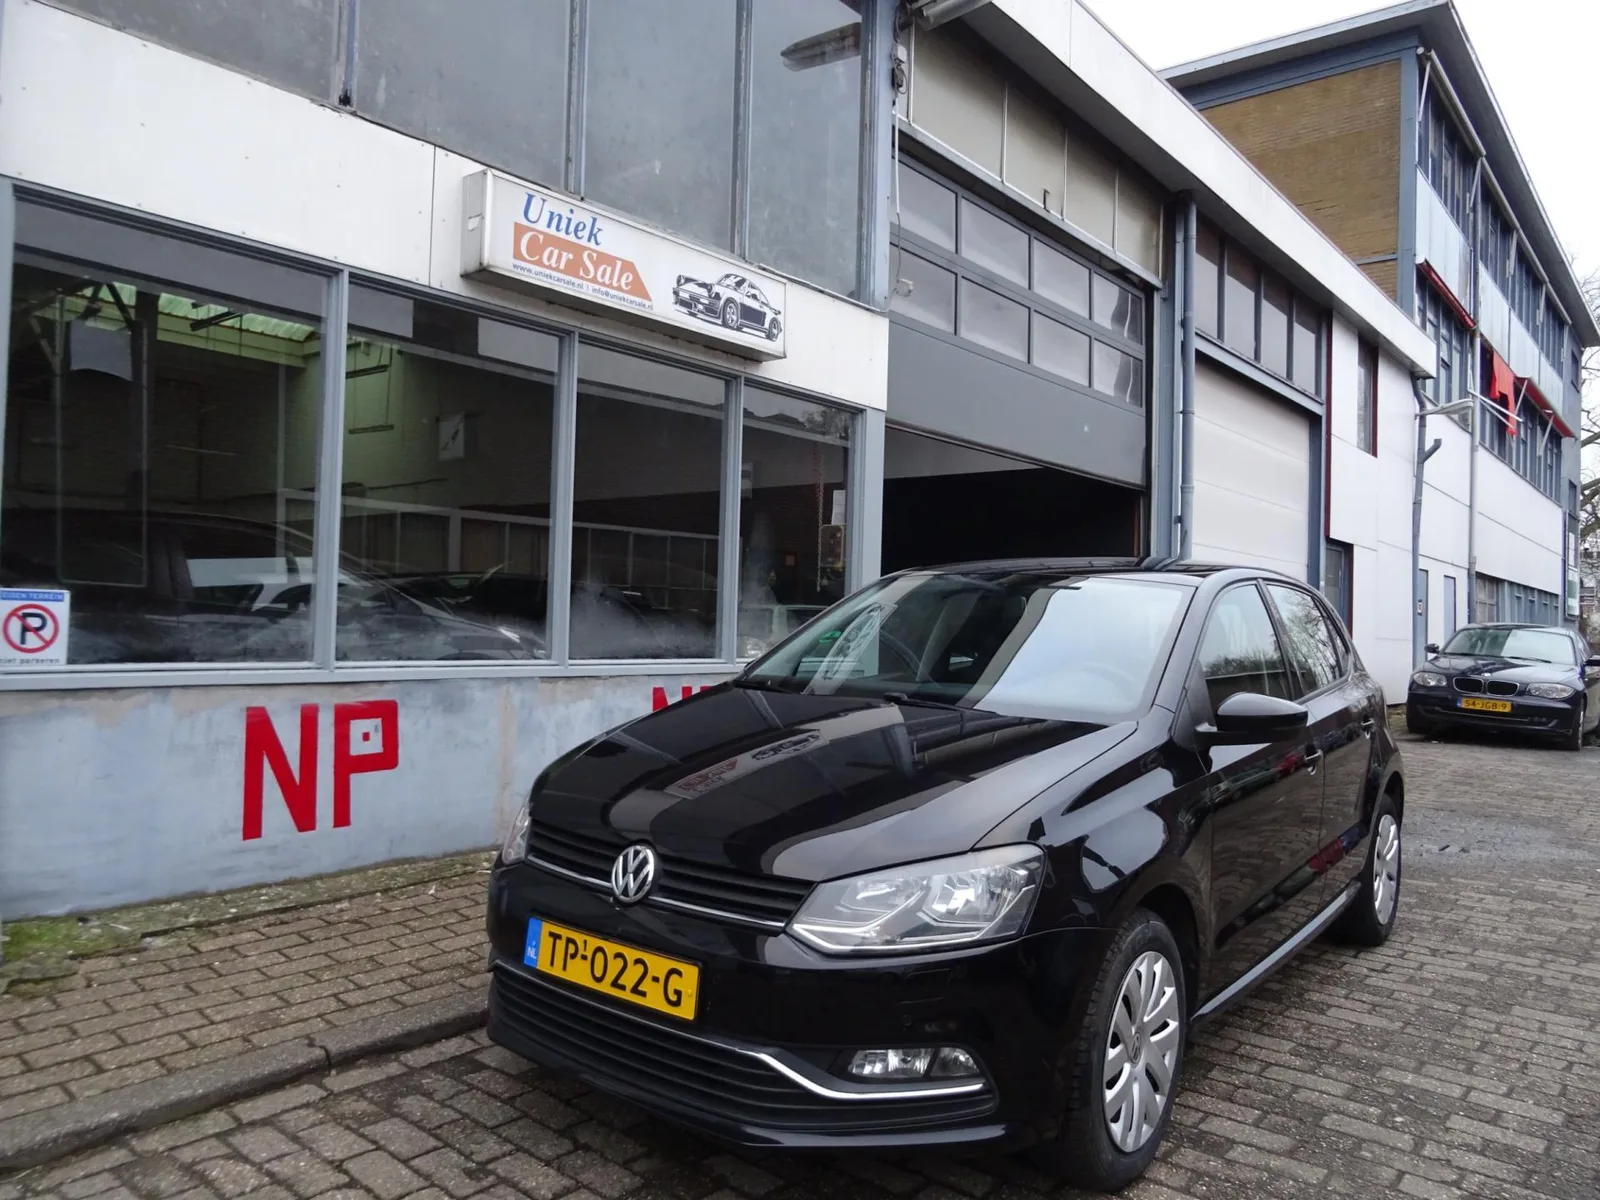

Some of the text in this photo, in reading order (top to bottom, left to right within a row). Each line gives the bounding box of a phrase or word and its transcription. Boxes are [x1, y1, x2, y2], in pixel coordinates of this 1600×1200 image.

[523, 192, 603, 246] Uniek
[512, 263, 584, 289] www.uniekcarsale.nl
[592, 286, 653, 310] info@uniekcarsale.nl
[520, 230, 634, 290] Car Sale
[20, 612, 47, 645] P
[242, 699, 399, 841] NP
[548, 931, 683, 1007] TP-022-G
